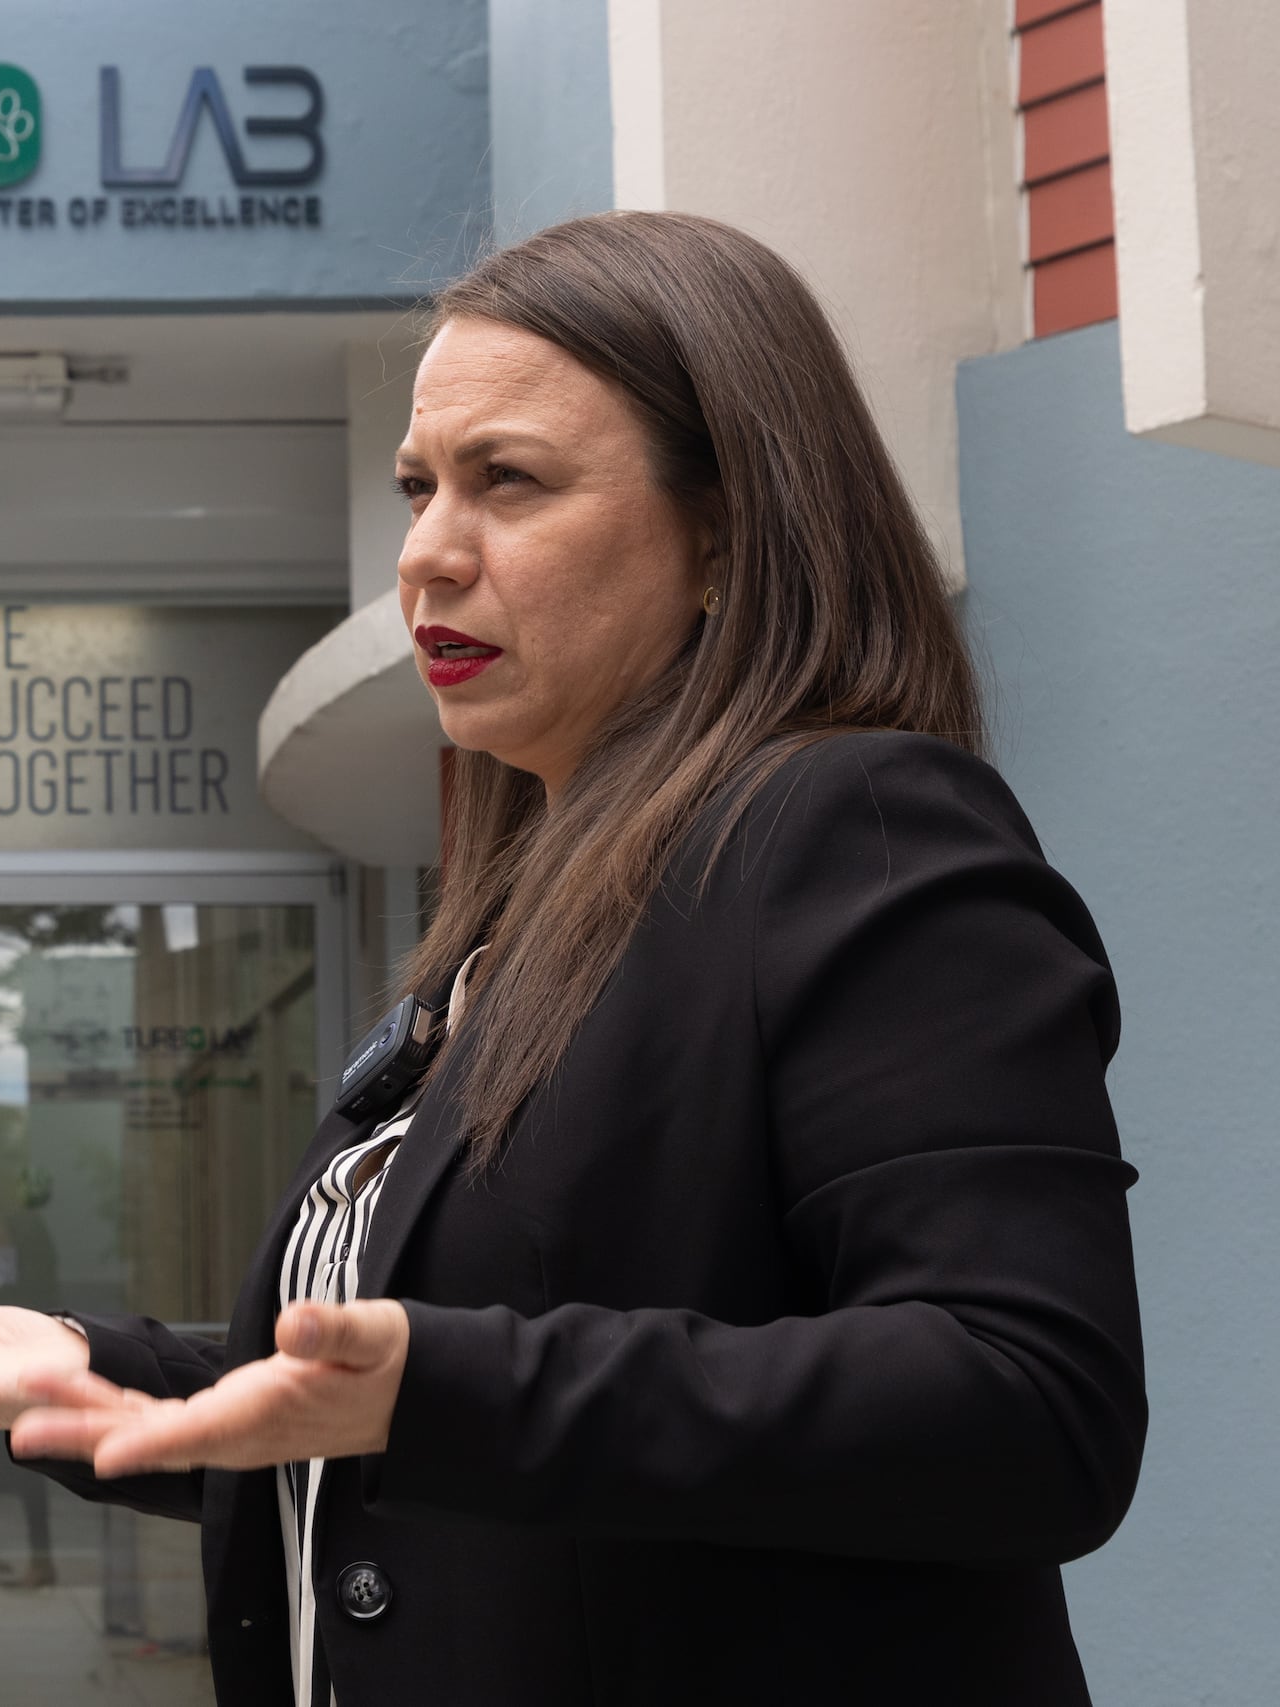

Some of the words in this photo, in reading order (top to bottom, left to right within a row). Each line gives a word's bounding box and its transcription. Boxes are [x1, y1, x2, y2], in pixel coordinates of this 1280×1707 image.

[100, 64, 328, 189] LAB
[68, 199, 110, 229] OF
[122, 198, 321, 229] EXCELLENCE
